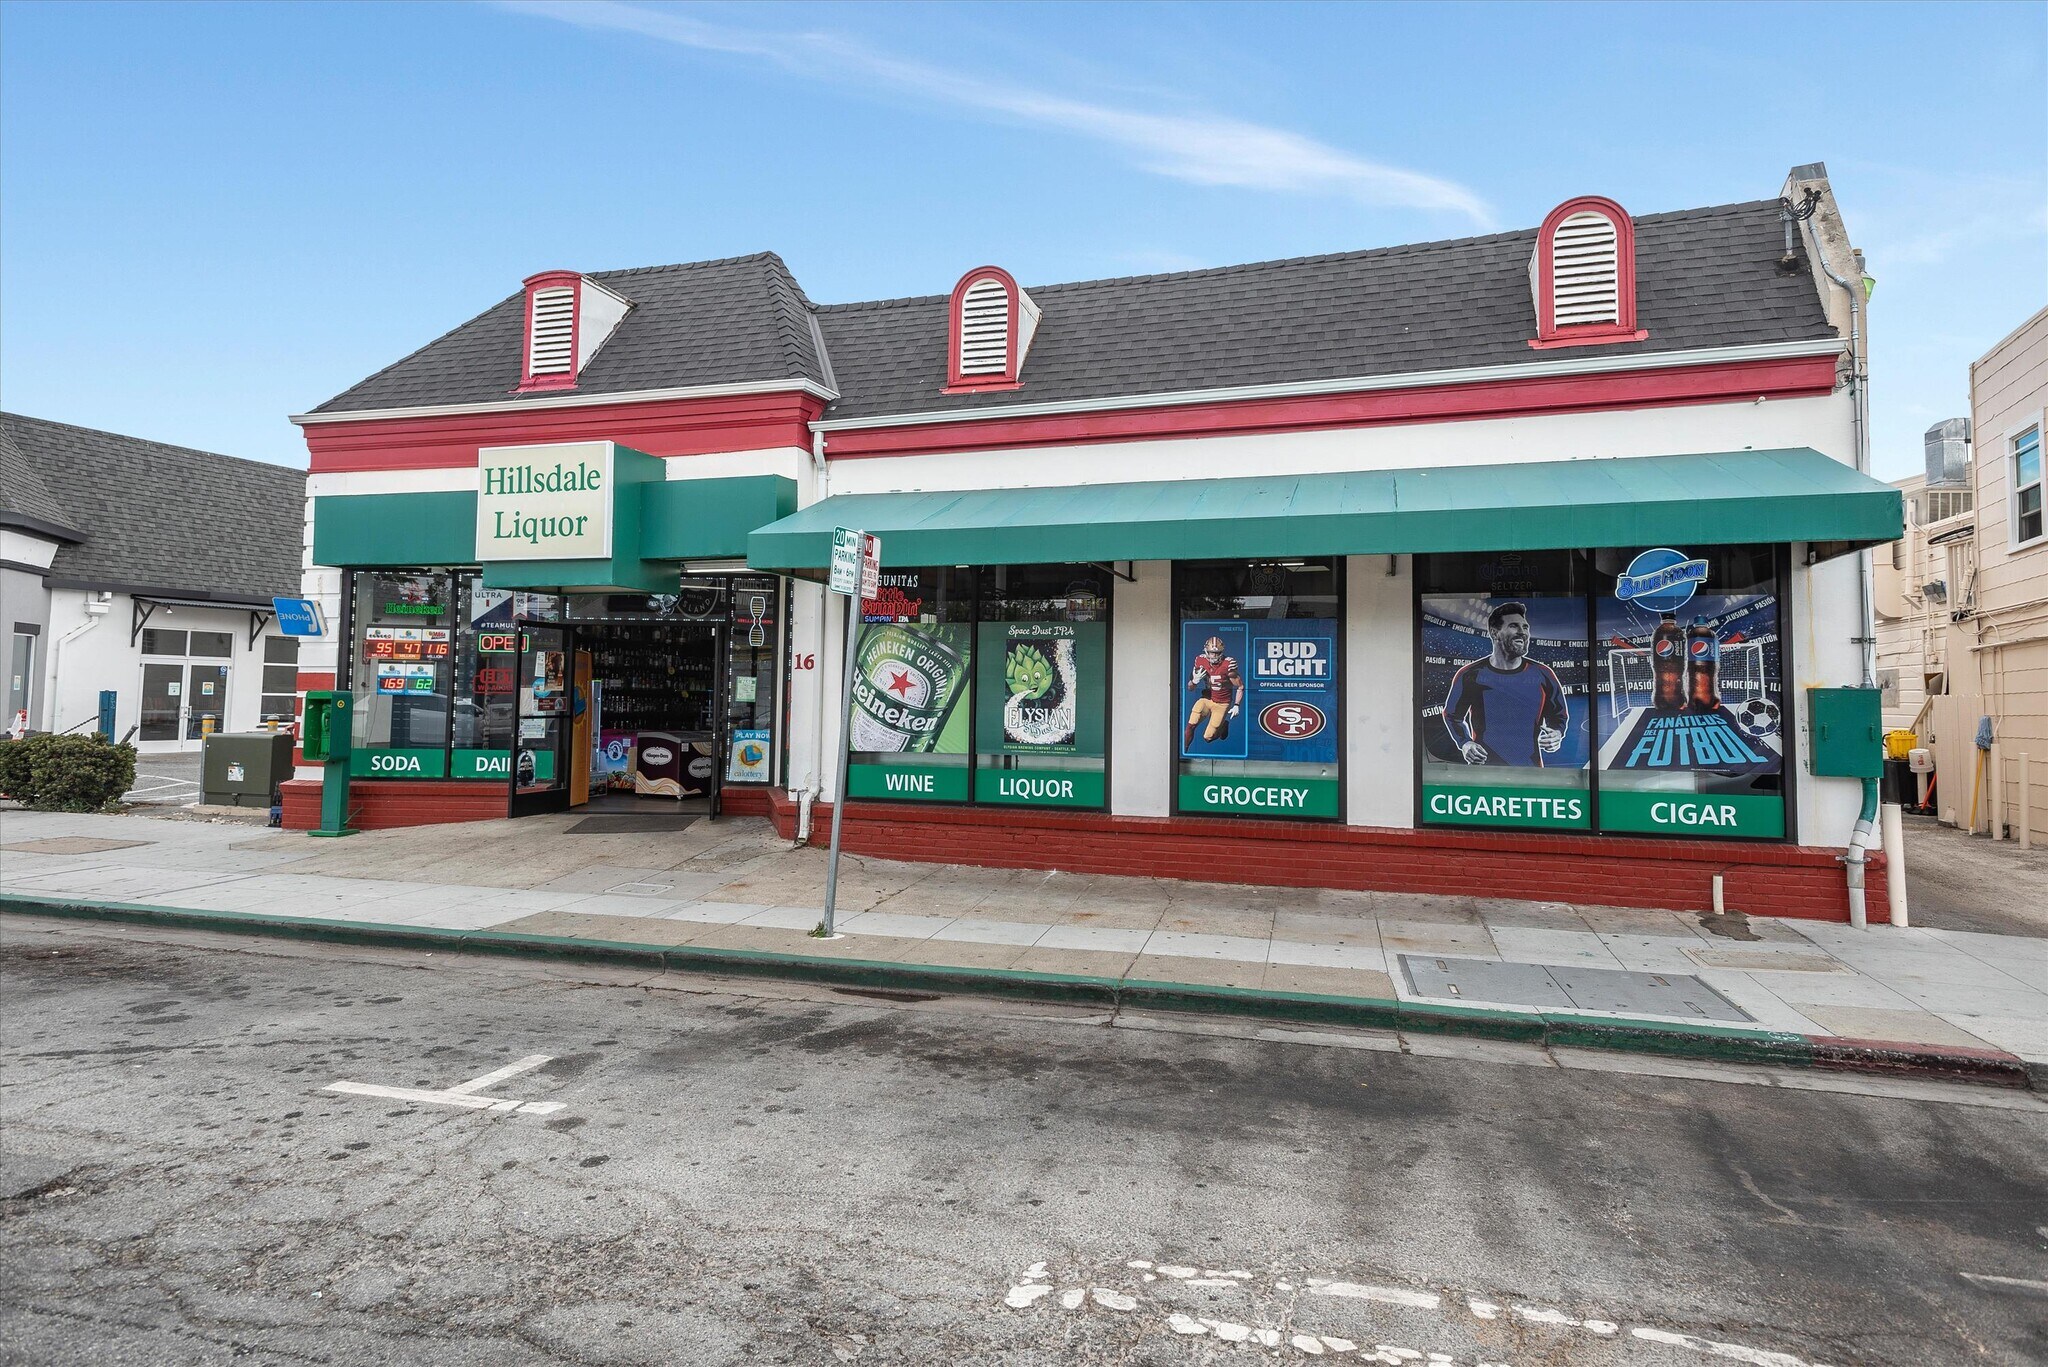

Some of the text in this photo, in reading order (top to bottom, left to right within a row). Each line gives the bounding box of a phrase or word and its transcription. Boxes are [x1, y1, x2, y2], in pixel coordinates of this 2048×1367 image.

[484, 462, 601, 495] Hillsdale
[494, 511, 588, 544] Liquor
[835, 529, 856, 547] 20 MIN
[834, 548, 856, 564] PARKING
[864, 557, 879, 571] ARKING
[877, 575, 919, 588] GUNITAS
[1491, 581, 1533, 591] SELTZER
[877, 587, 904, 601] ittle
[385, 602, 443, 615] Heineken
[279, 612, 311, 622] PHONE
[898, 615, 909, 623] IPA
[1008, 625, 1075, 638] Space Dust IPA
[376, 642, 393, 653] 95
[404, 643, 421, 653] 47
[427, 643, 448, 654] 116
[1267, 641, 1317, 659] BUD
[1536, 639, 1590, 648] ORGULLO EMOCIÓ
[794, 653, 815, 671] 16
[1425, 656, 1446, 665] PASIÓN
[1552, 660, 1574, 668] PASIÓN
[866, 640, 915, 666] HEINEKEN
[916, 655, 948, 701] ORIGINAL
[384, 678, 405, 689] 169
[416, 679, 433, 690] 62
[1627, 680, 1652, 691] PASIÓ
[1721, 680, 1759, 690] EMOCIÓN
[852, 666, 938, 731] Heineken
[1008, 706, 1072, 730] ELYSIAN
[1646, 714, 1728, 729] FANÁTICOS
[1625, 725, 1769, 768] FUTBOL
[371, 755, 421, 772] SODA
[476, 757, 511, 772] DAI
[886, 773, 934, 793] WINE
[999, 777, 1074, 799] LIQUOR
[1203, 785, 1309, 808] GROCERY
[1430, 795, 1582, 820] CIGARETTES
[1650, 802, 1738, 827] CIGAR
